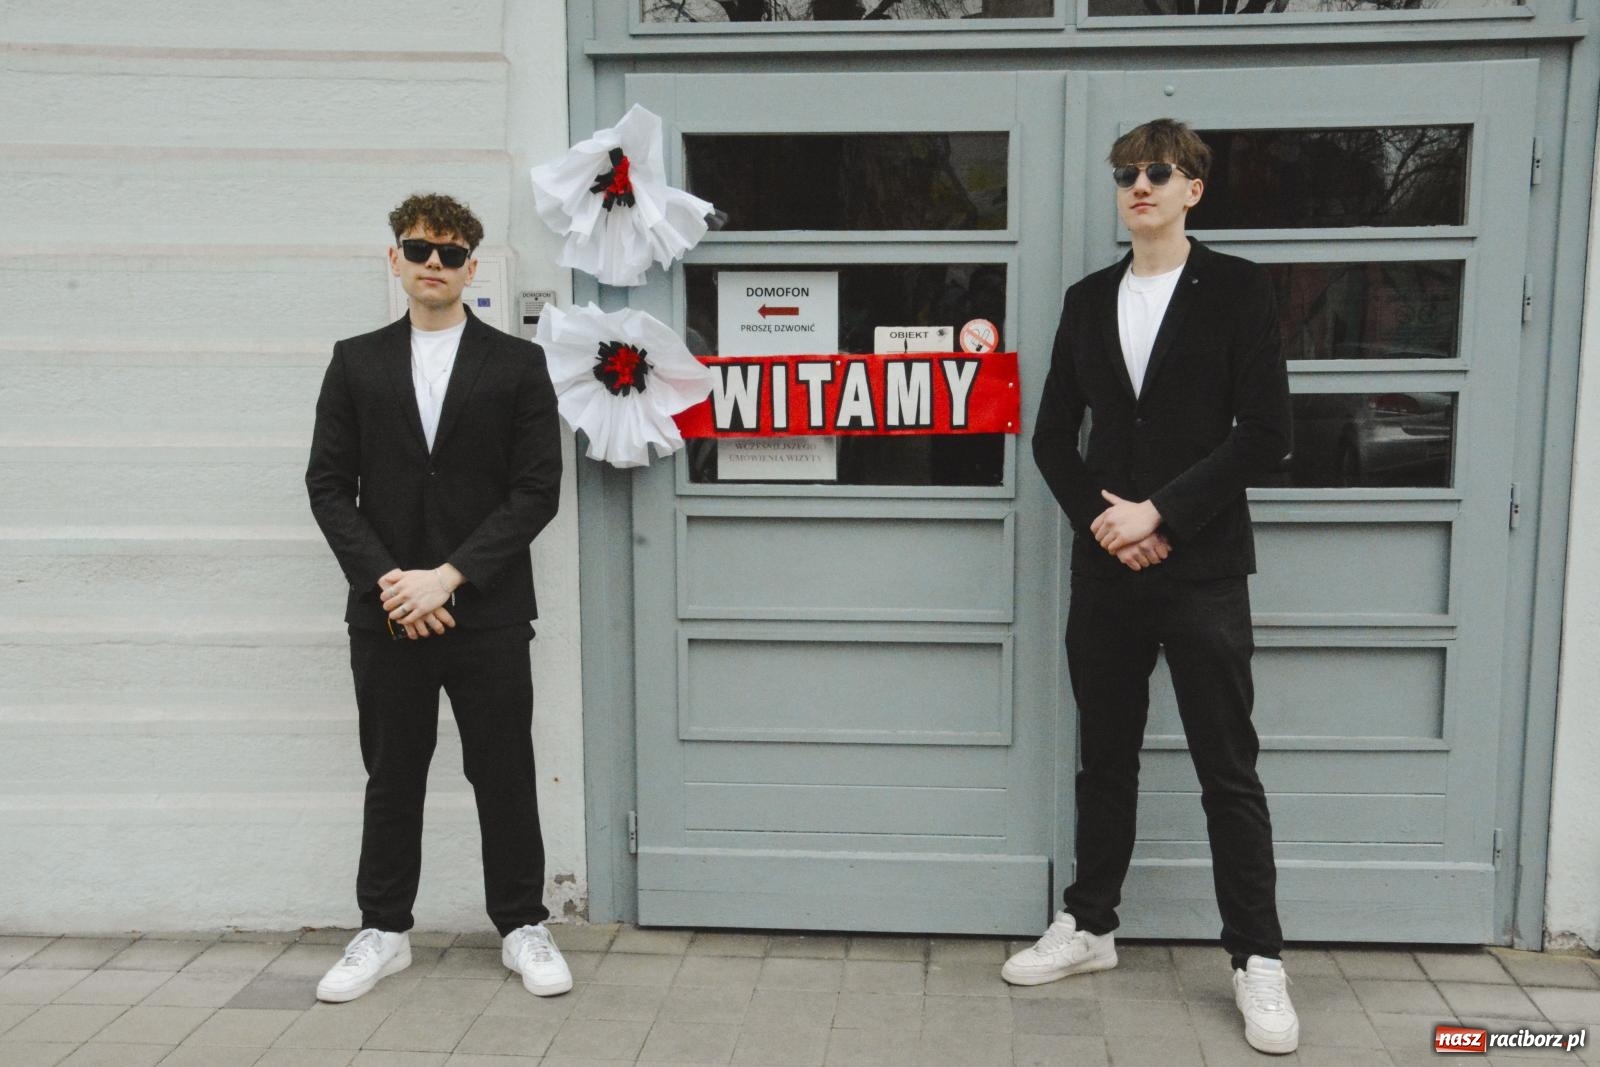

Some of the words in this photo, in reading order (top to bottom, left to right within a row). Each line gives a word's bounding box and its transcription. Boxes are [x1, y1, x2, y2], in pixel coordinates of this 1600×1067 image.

[745, 287, 810, 297] DOMOFON
[740, 324, 772, 333] PROSZĘ
[774, 323, 816, 332] DZWONIĆ
[889, 331, 929, 339] OBIEKT
[708, 359, 981, 432] WITAMY
